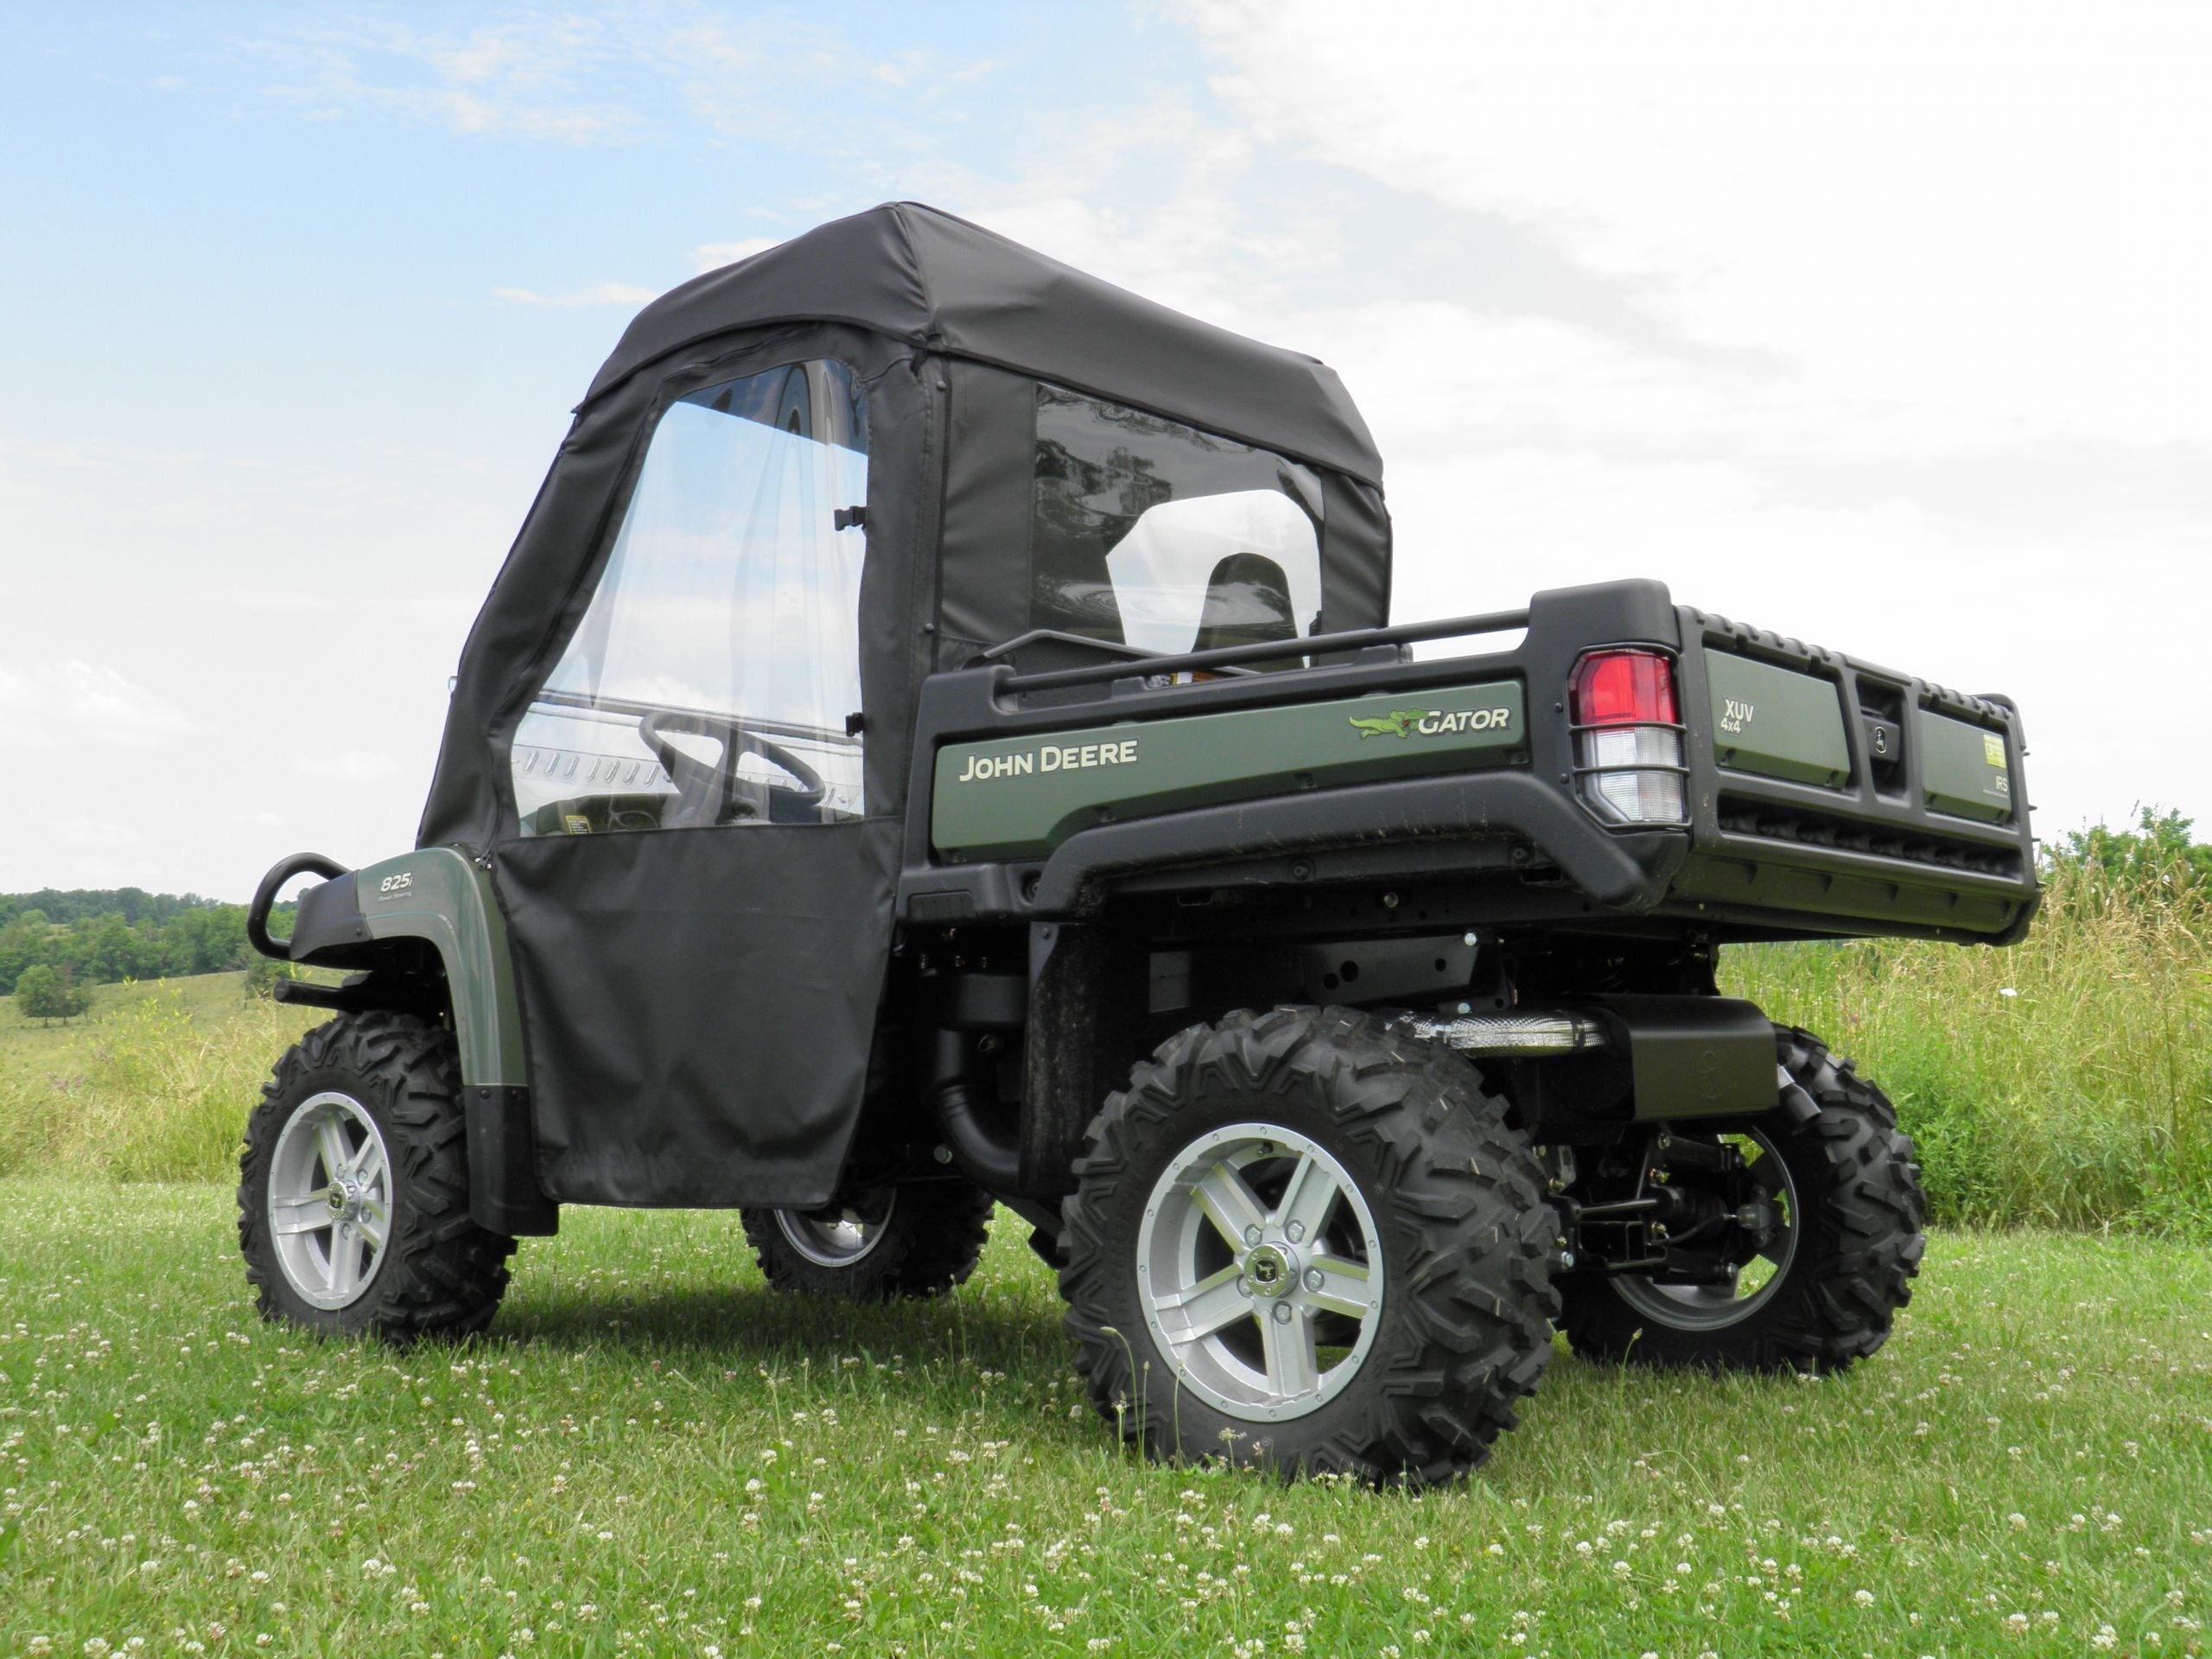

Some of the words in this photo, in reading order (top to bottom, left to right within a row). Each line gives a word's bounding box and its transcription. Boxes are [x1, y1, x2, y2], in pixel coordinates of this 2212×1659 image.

[1418, 708, 1510, 734] GATOR
[1725, 699, 1754, 722] XUV
[1720, 717, 1741, 734] 4x4
[959, 753, 1033, 782] JOHN
[1040, 741, 1138, 772] DEERE
